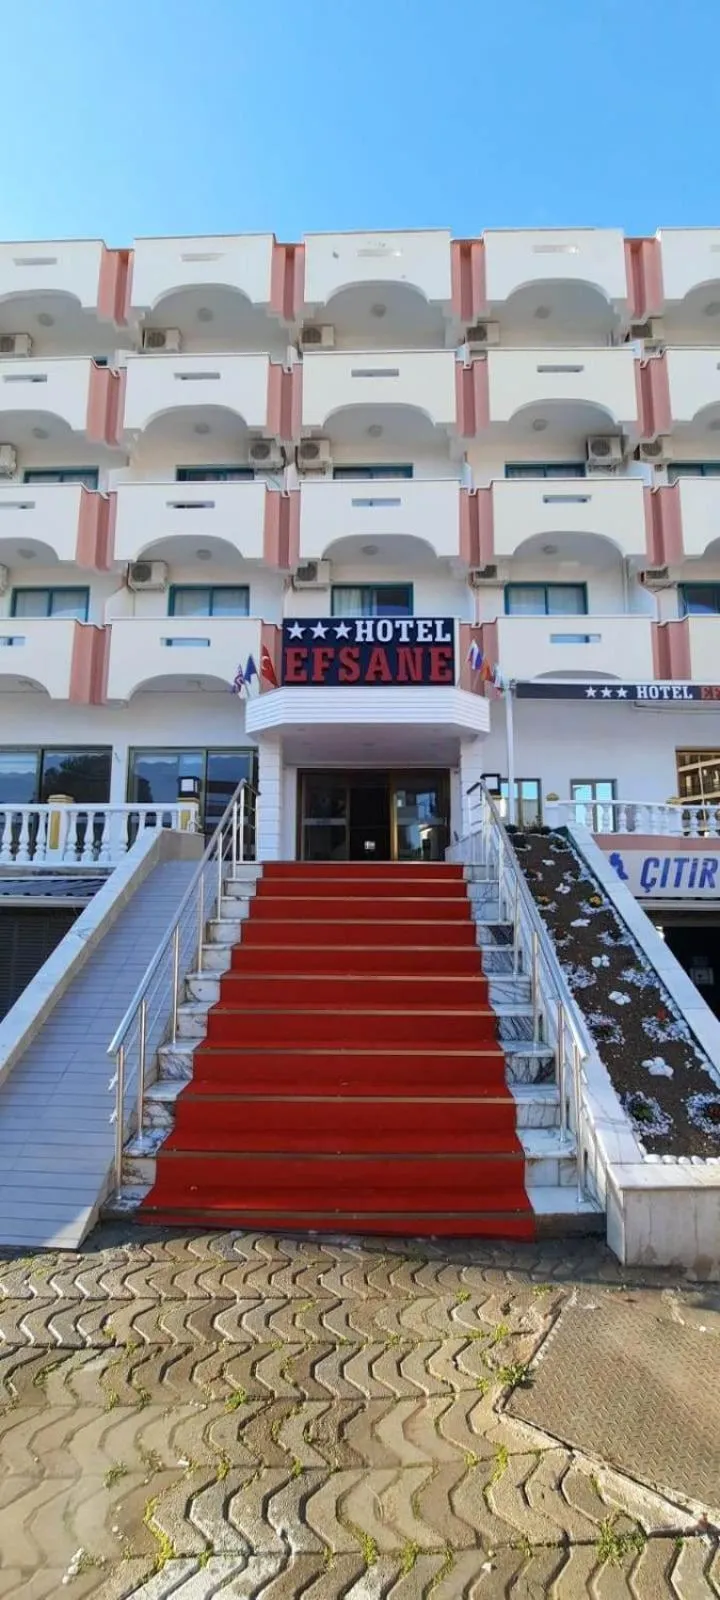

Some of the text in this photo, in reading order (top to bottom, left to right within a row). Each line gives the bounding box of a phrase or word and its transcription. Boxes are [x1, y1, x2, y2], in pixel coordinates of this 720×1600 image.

[354, 619, 451, 642] HOTEL
[284, 646, 453, 682] EFSANE
[636, 686, 693, 699] HOTEL
